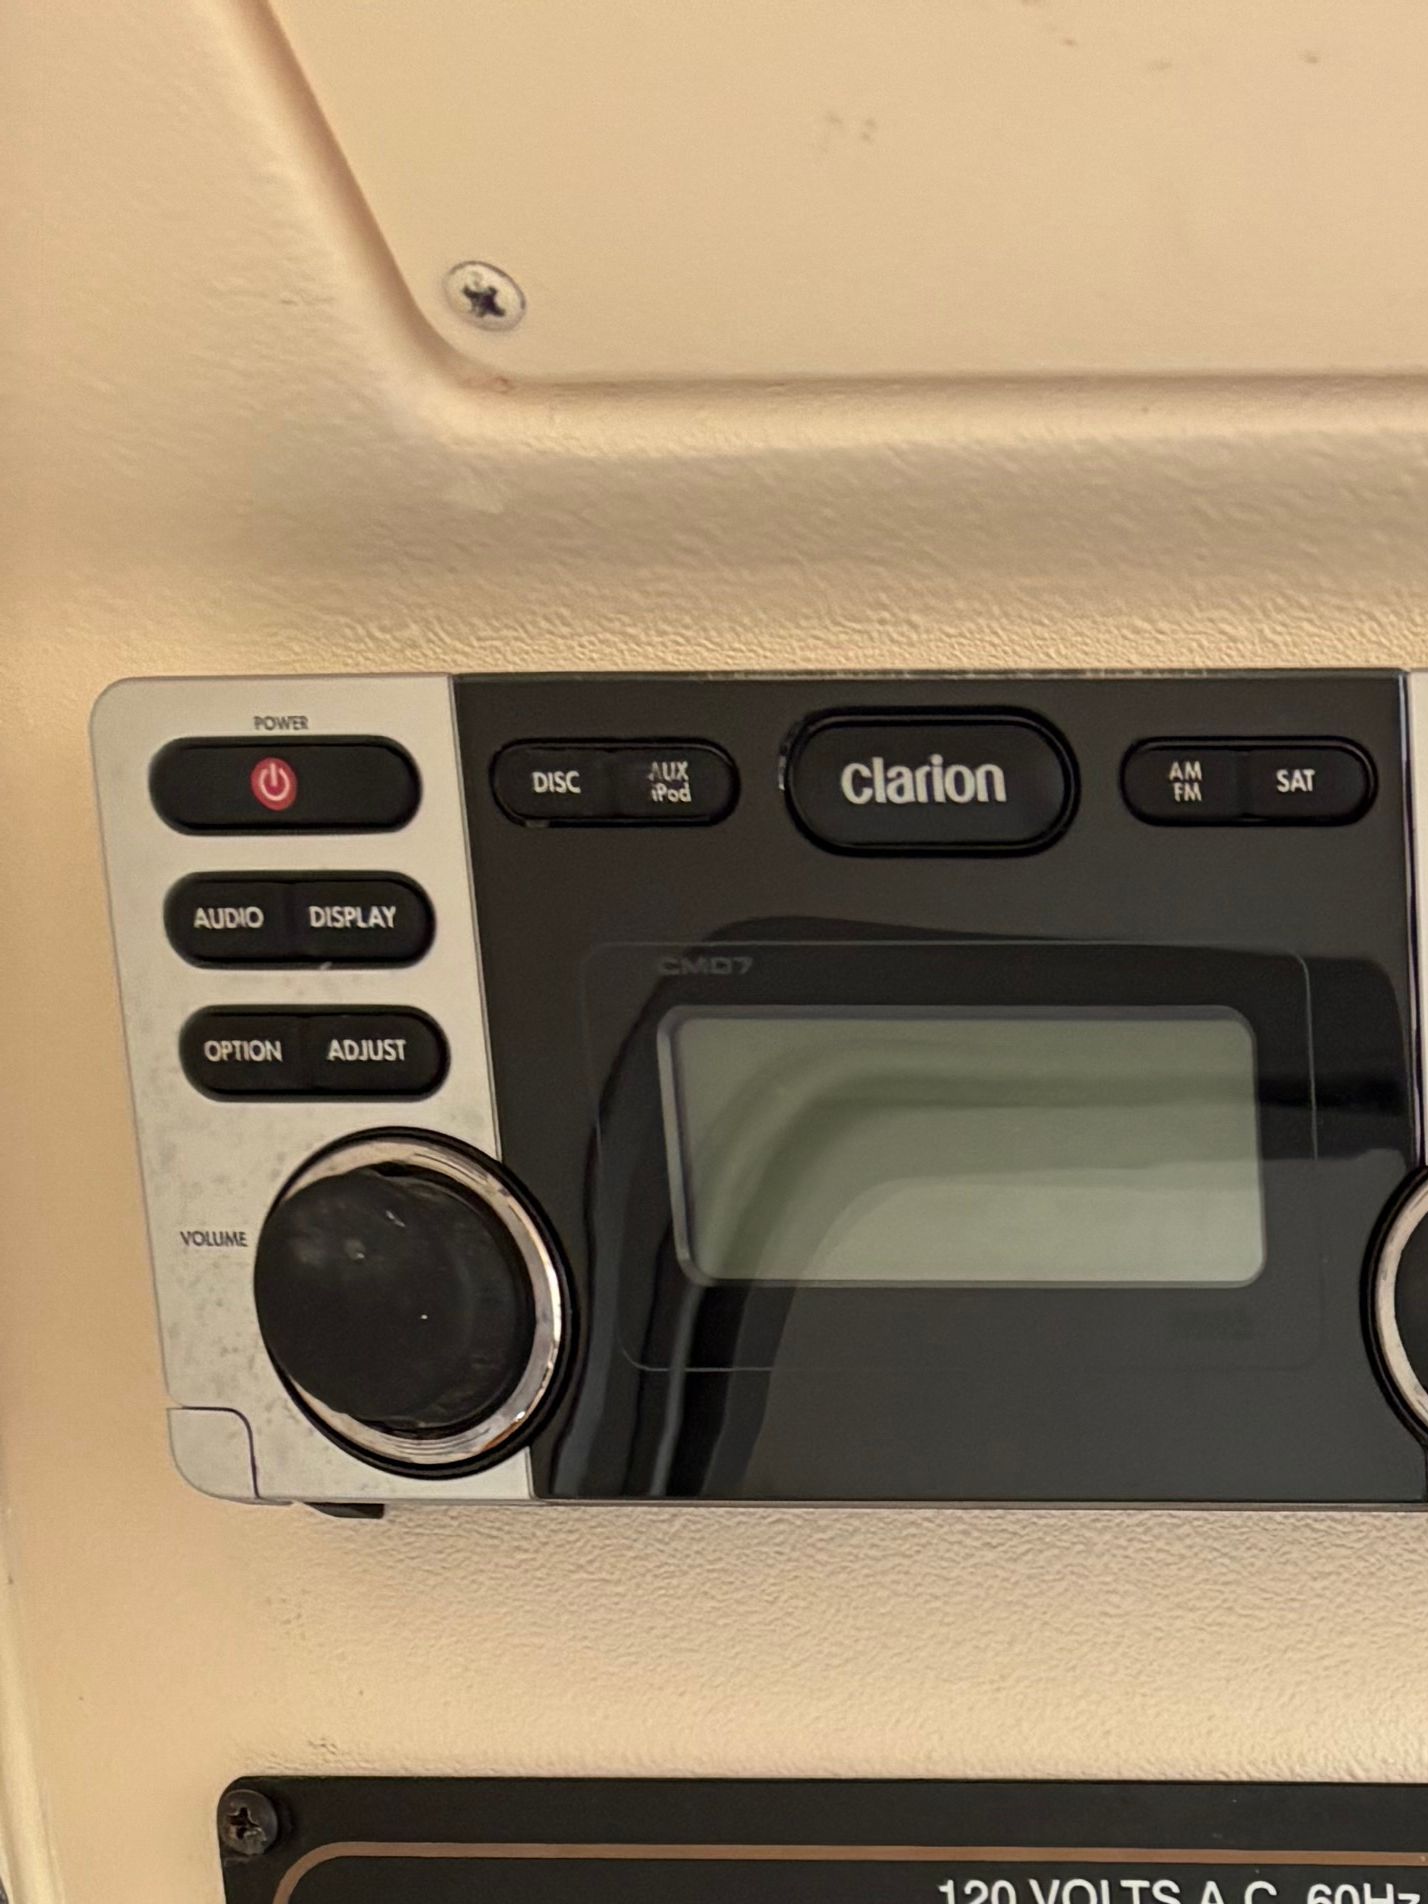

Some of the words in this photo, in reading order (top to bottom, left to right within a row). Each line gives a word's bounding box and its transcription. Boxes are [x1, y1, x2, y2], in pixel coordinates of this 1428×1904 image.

[254, 716, 308, 730] POWER
[649, 762, 688, 781] AUX
[1170, 762, 1201, 780] AM
[1277, 769, 1314, 792] SAT
[533, 771, 580, 793] DISC
[652, 782, 691, 802] iPod
[1174, 783, 1201, 801] FM
[194, 907, 263, 929] AUDIO
[309, 906, 396, 928] DISPLAY
[205, 1040, 282, 1061] OPTION
[328, 1039, 405, 1060] ADJUST
[180, 1231, 248, 1247] VOLUME
